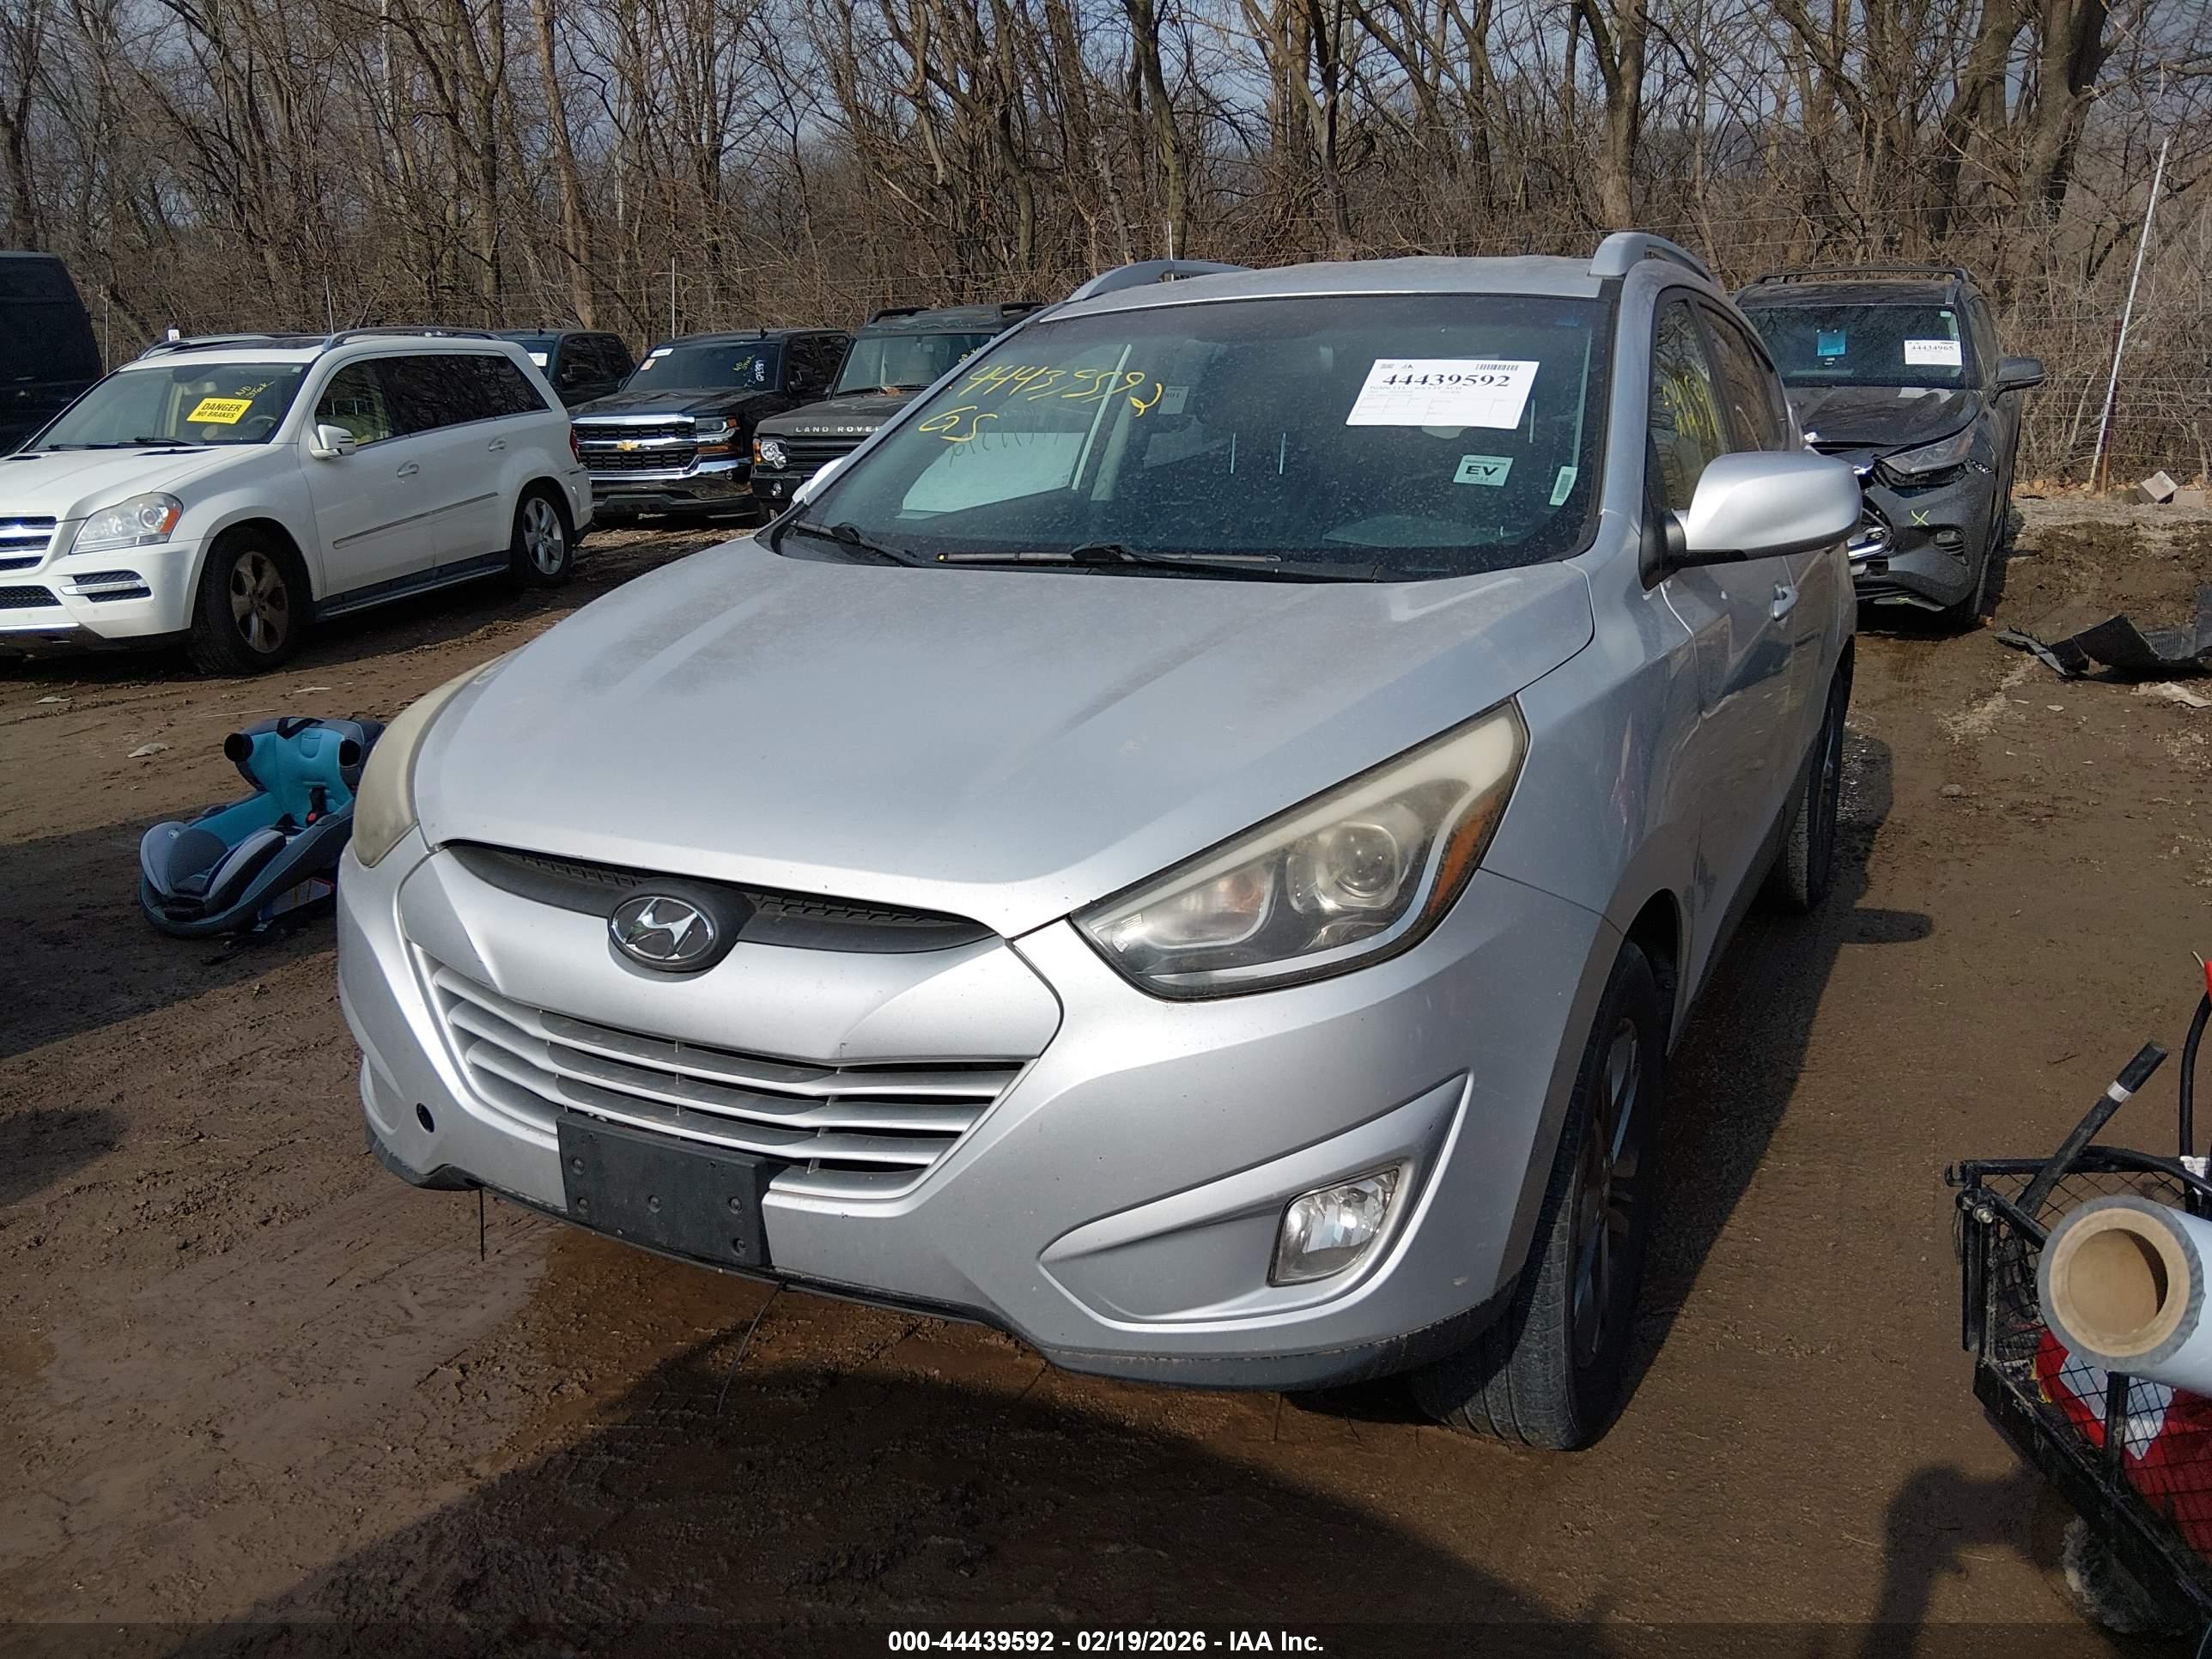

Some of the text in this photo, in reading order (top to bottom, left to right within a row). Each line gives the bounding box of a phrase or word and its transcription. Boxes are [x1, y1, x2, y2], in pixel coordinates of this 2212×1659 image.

[1382, 374, 1510, 387] 44439592
[201, 403, 242, 412] DANGER
[1465, 465, 1499, 476] EV
